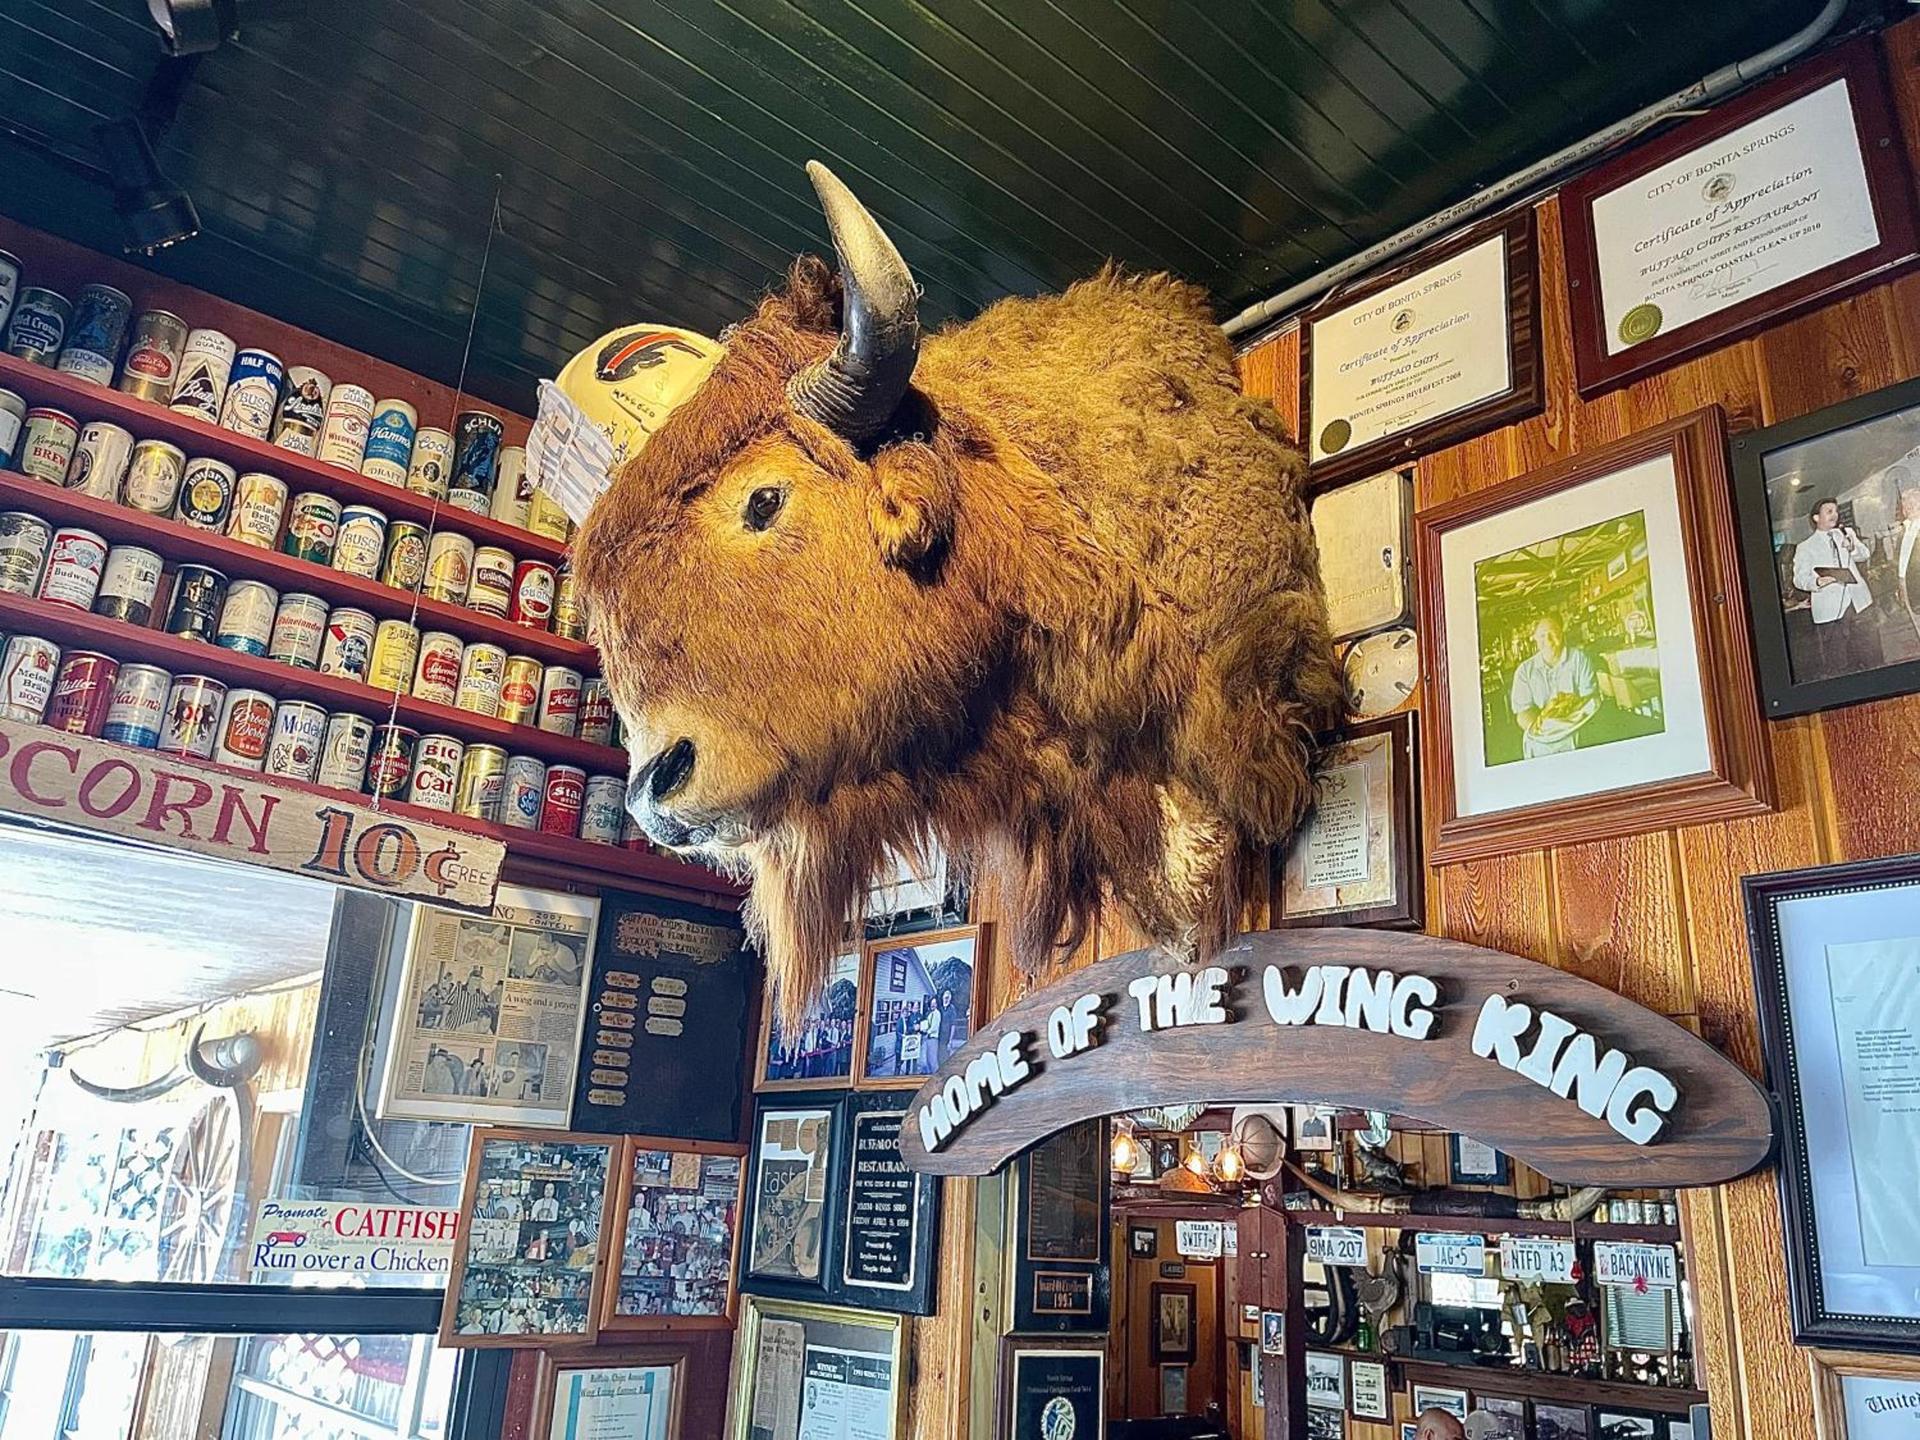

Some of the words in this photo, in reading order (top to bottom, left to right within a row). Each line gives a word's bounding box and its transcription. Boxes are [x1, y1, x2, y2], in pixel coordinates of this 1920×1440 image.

[1647, 179, 1676, 200] CITY
[1676, 170, 1692, 184] OF
[1696, 150, 1742, 177] BONITA
[1743, 123, 1796, 154] SPRINGS
[1634, 216, 1702, 254] Certificate
[1706, 204, 1721, 224] of
[1721, 167, 1813, 214] Appreciation
[1639, 247, 1694, 277] BUFFALO
[1733, 189, 1821, 236] RESTAURANT
[1715, 251, 1756, 274] COASTAL
[1757, 238, 1789, 260] CLEAN
[1353, 312, 1373, 326] CITY
[1375, 306, 1386, 316] OF
[1388, 290, 1422, 311] BONITA
[1423, 269, 1463, 294] SPRINGS
[196, 342, 227, 355] QUART
[200, 335, 225, 345] HALF
[1339, 346, 1388, 373] Certificate
[1390, 338, 1403, 352] of
[1402, 311, 1471, 346] Appreciation
[241, 356, 264, 368] HALF
[33, 447, 66, 467] BREW
[425, 744, 458, 760] BIG
[416, 770, 455, 794] Cat
[0, 731, 281, 854] CORN
[448, 863, 490, 885] FREE
[415, 796, 450, 807] LIQUOR
[506, 994, 512, 1002] A
[554, 1001, 578, 1010] prayer
[918, 1032, 1032, 1154] HOME
[1047, 996, 1103, 1060] OF
[1128, 965, 1229, 1033] THE
[1261, 964, 1439, 1042] WING
[1471, 993, 1679, 1146] KING
[262, 1204, 328, 1220] Promote
[335, 1207, 460, 1240] CATFISH
[253, 1243, 296, 1268] Run
[302, 1251, 350, 1269] over
[354, 1256, 365, 1269] a
[370, 1247, 449, 1271] Chicken
[1309, 1239, 1334, 1257] 9MA
[1338, 1240, 1363, 1258] 207
[1511, 1249, 1542, 1271] NTFD
[1550, 1252, 1565, 1272] A3
[1611, 1253, 1671, 1279] BACKNYNE
